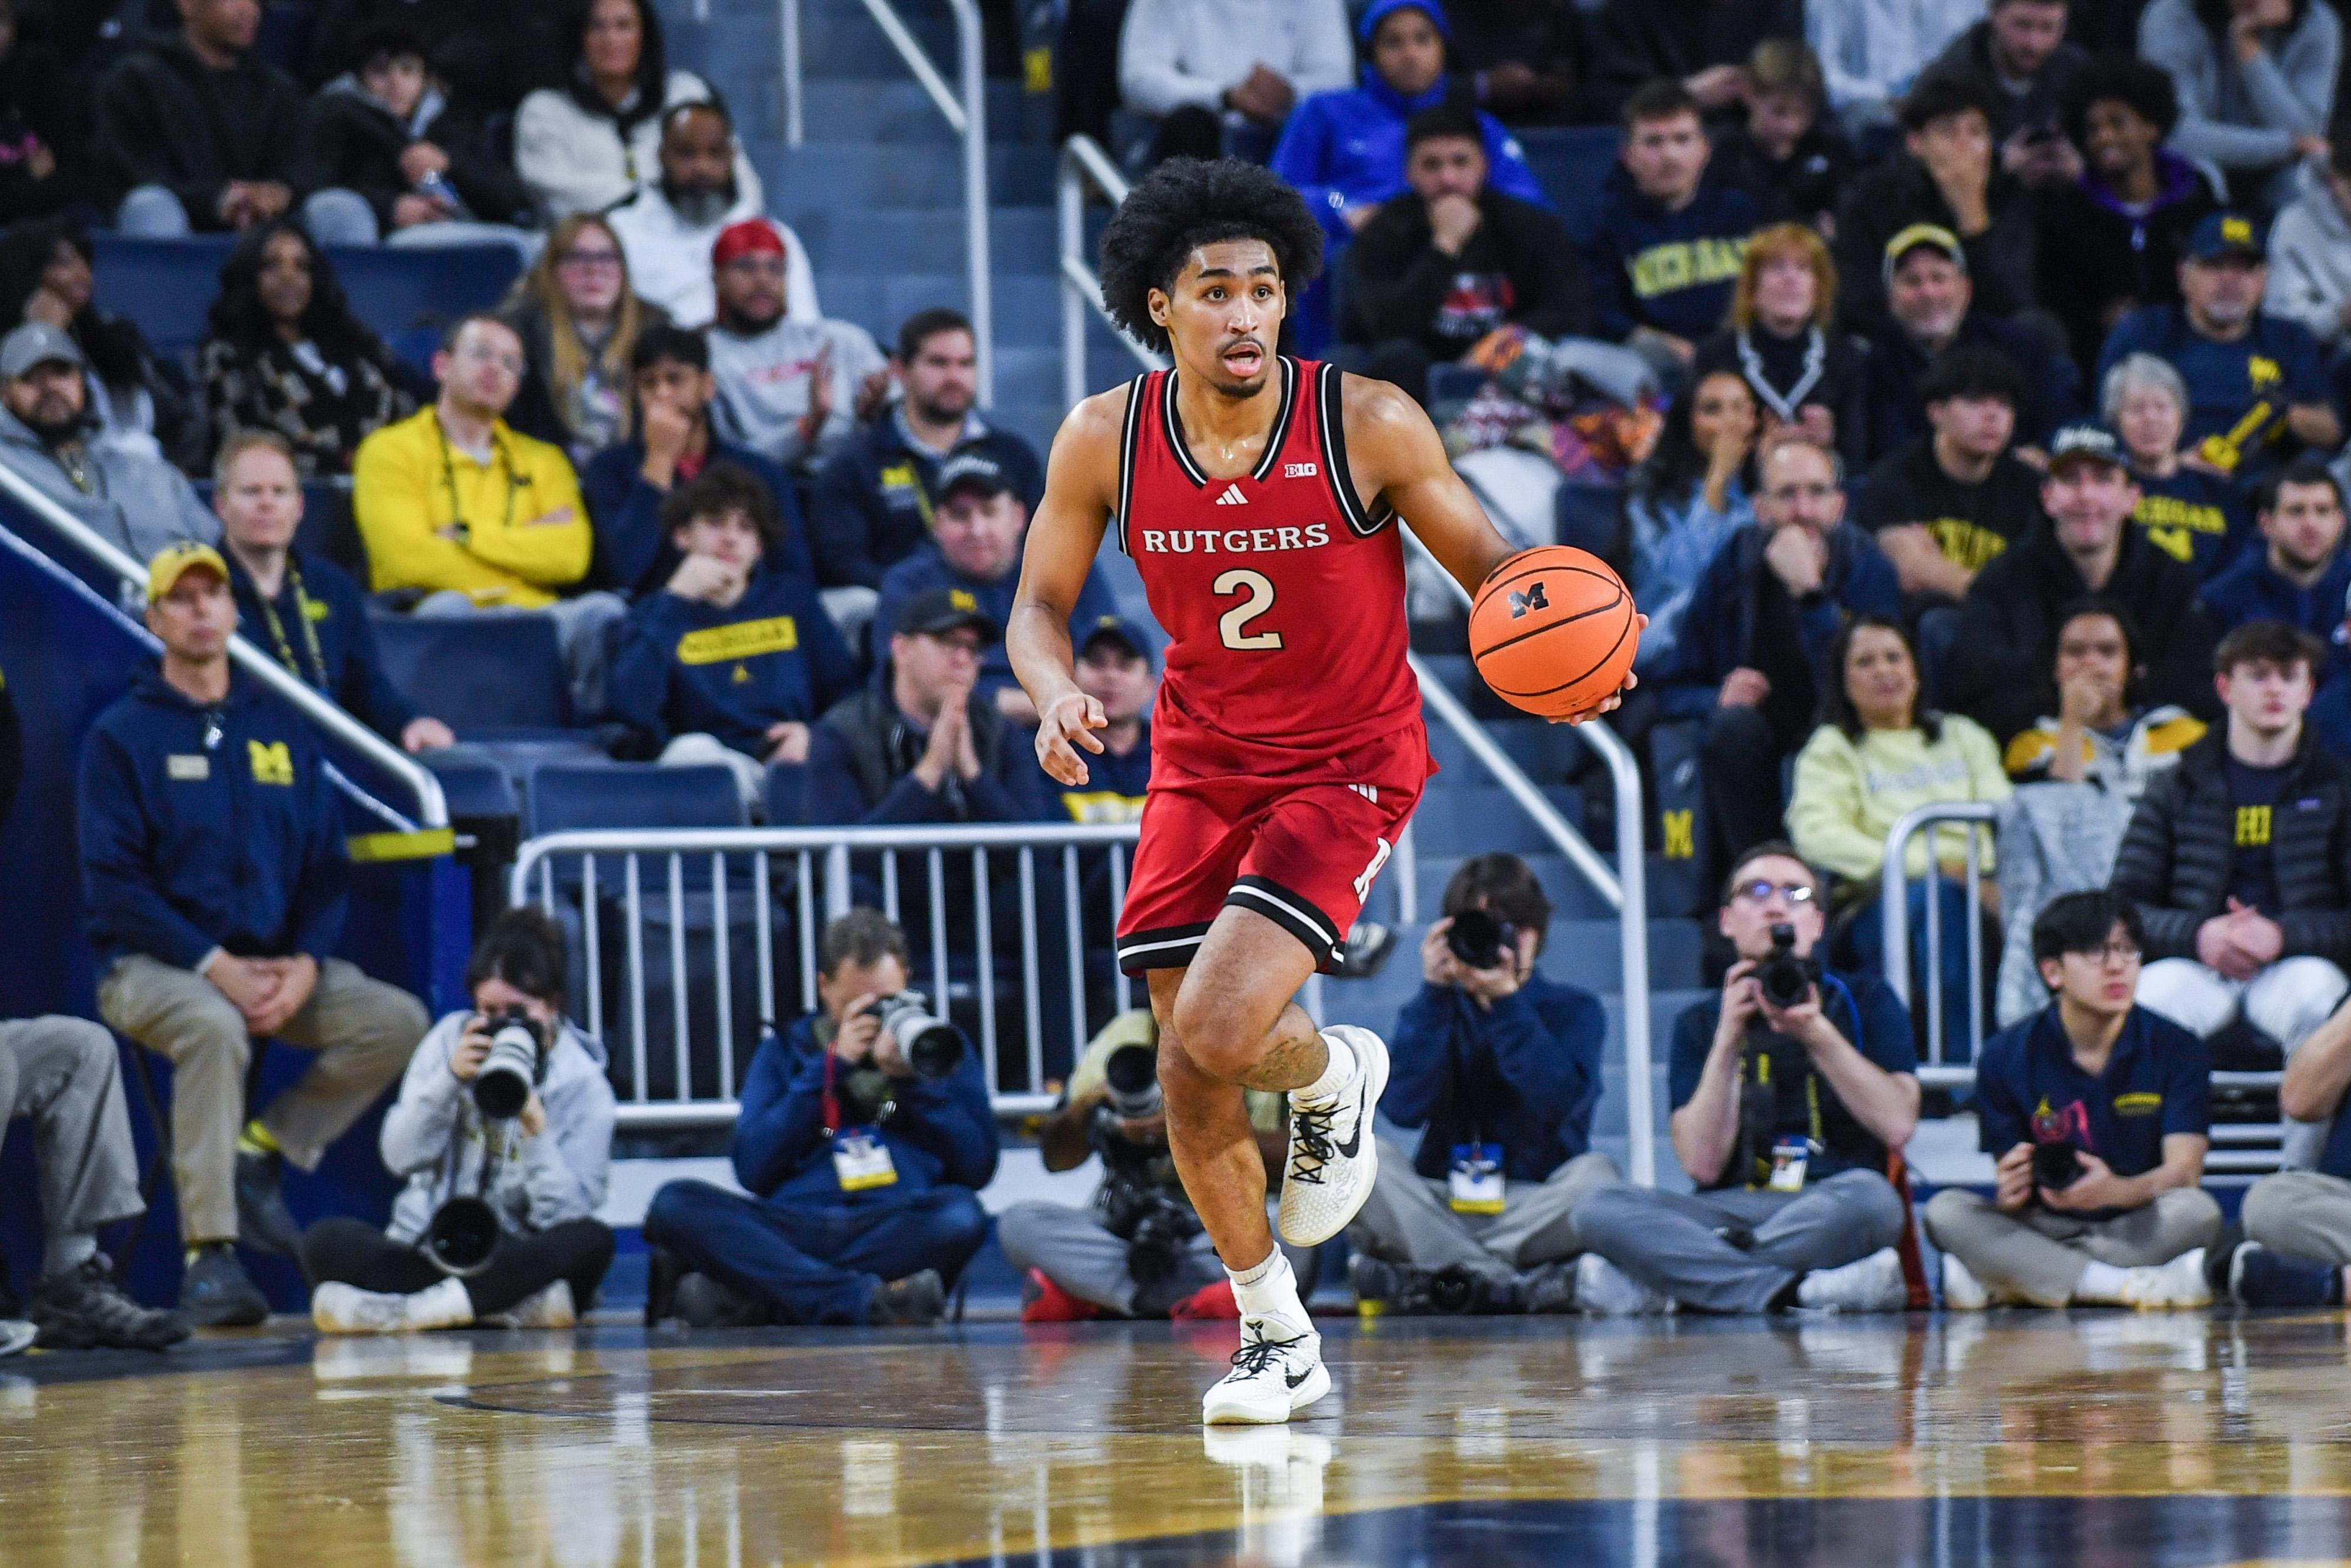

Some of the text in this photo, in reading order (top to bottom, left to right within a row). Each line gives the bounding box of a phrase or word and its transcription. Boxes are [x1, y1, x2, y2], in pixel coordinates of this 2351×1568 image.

[1142, 523, 1329, 553] RUTGERS
[1213, 568, 1284, 650] 2
[1507, 582, 1549, 619] M
[248, 739, 293, 785] M
